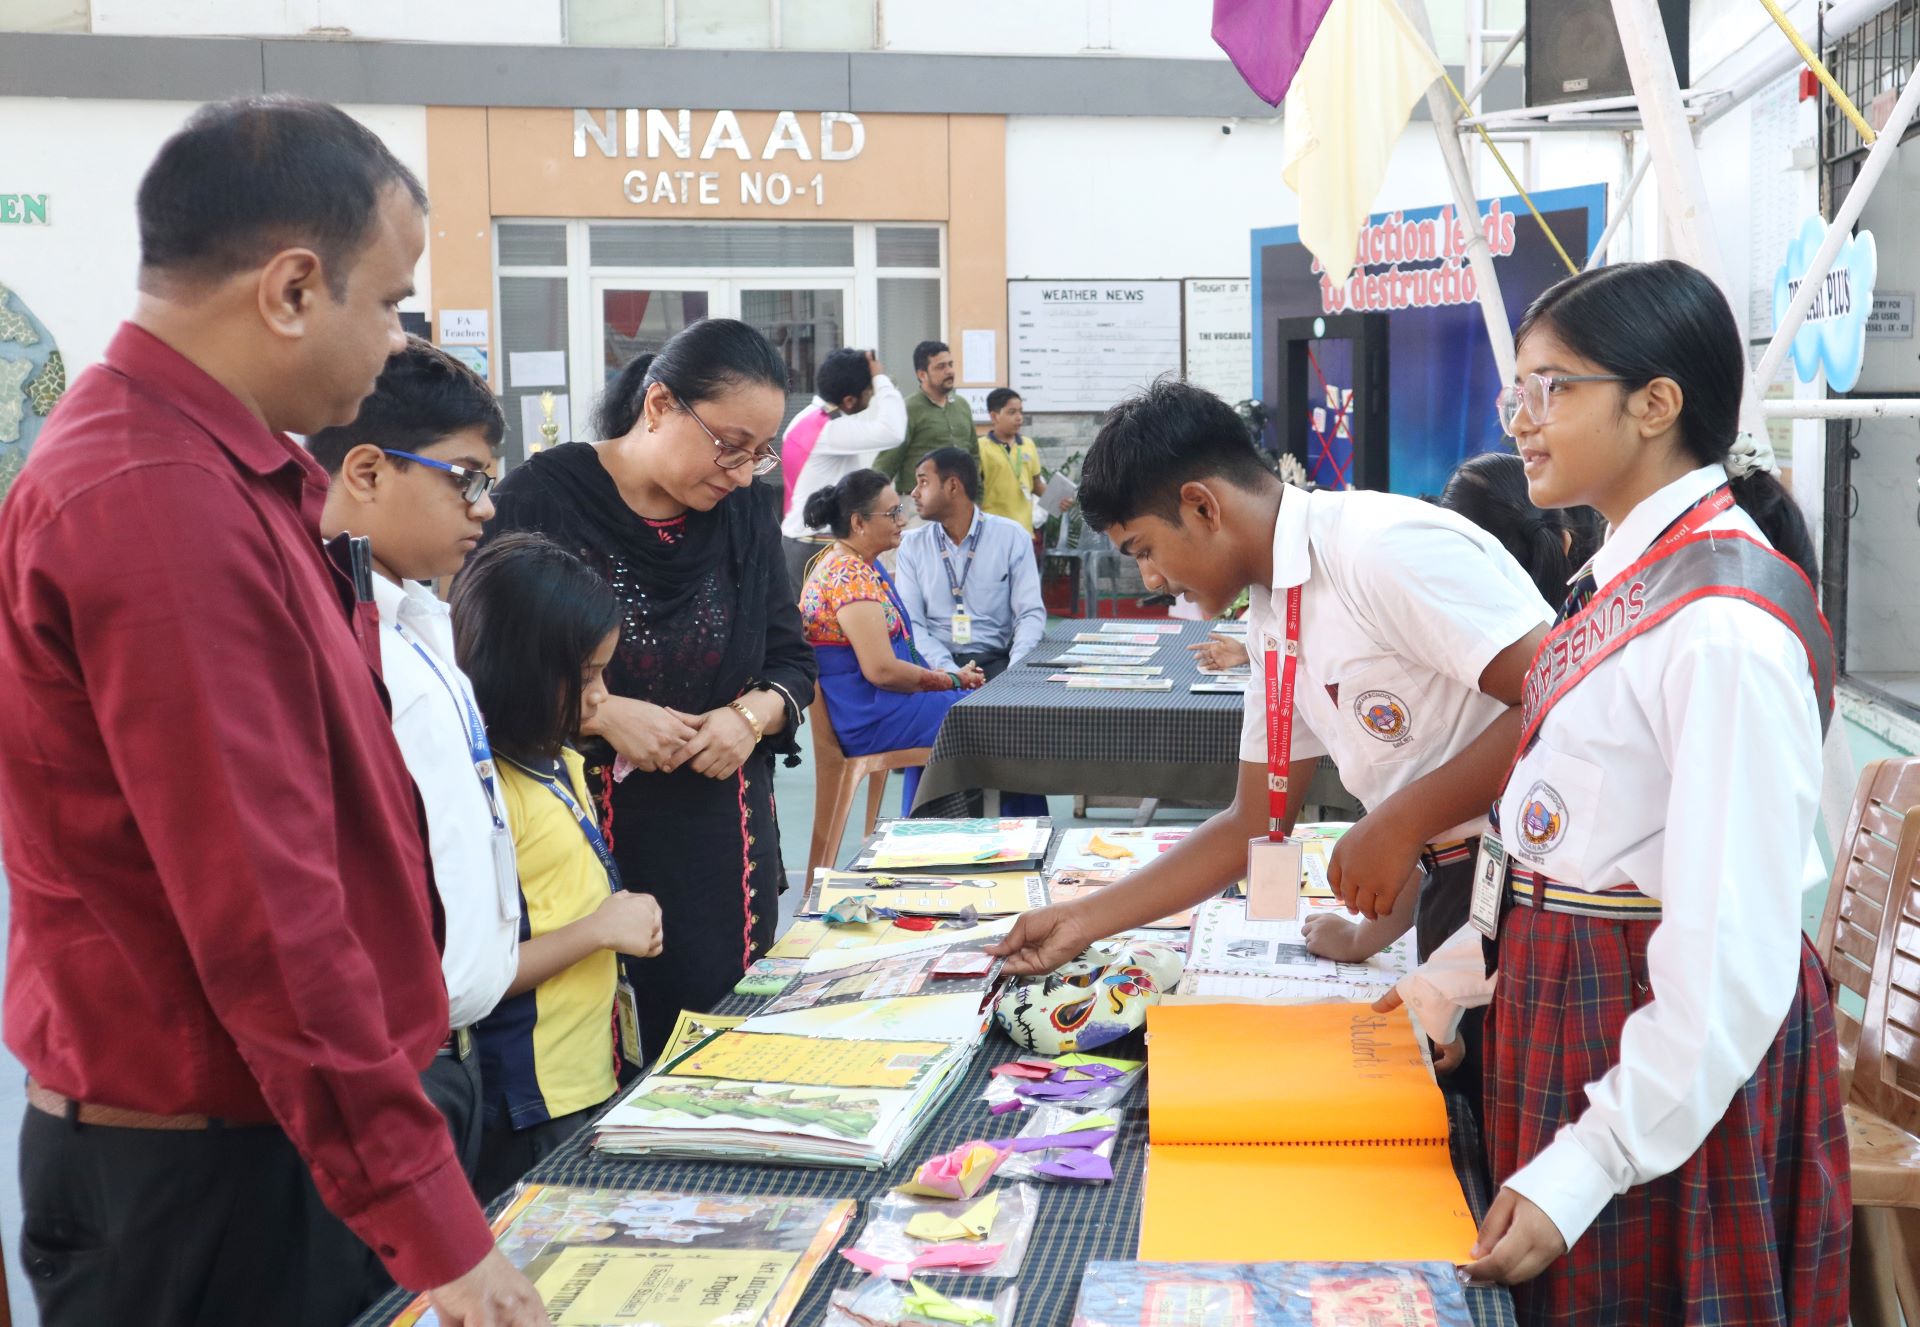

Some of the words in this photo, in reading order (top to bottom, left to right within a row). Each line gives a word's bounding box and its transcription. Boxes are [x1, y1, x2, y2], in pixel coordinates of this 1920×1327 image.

[573, 108, 866, 161] NINAAD
[623, 169, 720, 205] GATE
[740, 171, 824, 206] NO-1
[1442, 198, 1516, 257] leds
[1042, 289, 1098, 301] WEATHER
[1106, 289, 1144, 301] NEWS
[1351, 257, 1478, 311] destructio
[1826, 268, 1851, 318] PLUS
[444, 328, 486, 337] Teachers
[1280, 682, 1292, 716] School
[1277, 721, 1289, 767] Sunbeam
[700, 1275, 739, 1306] Project
